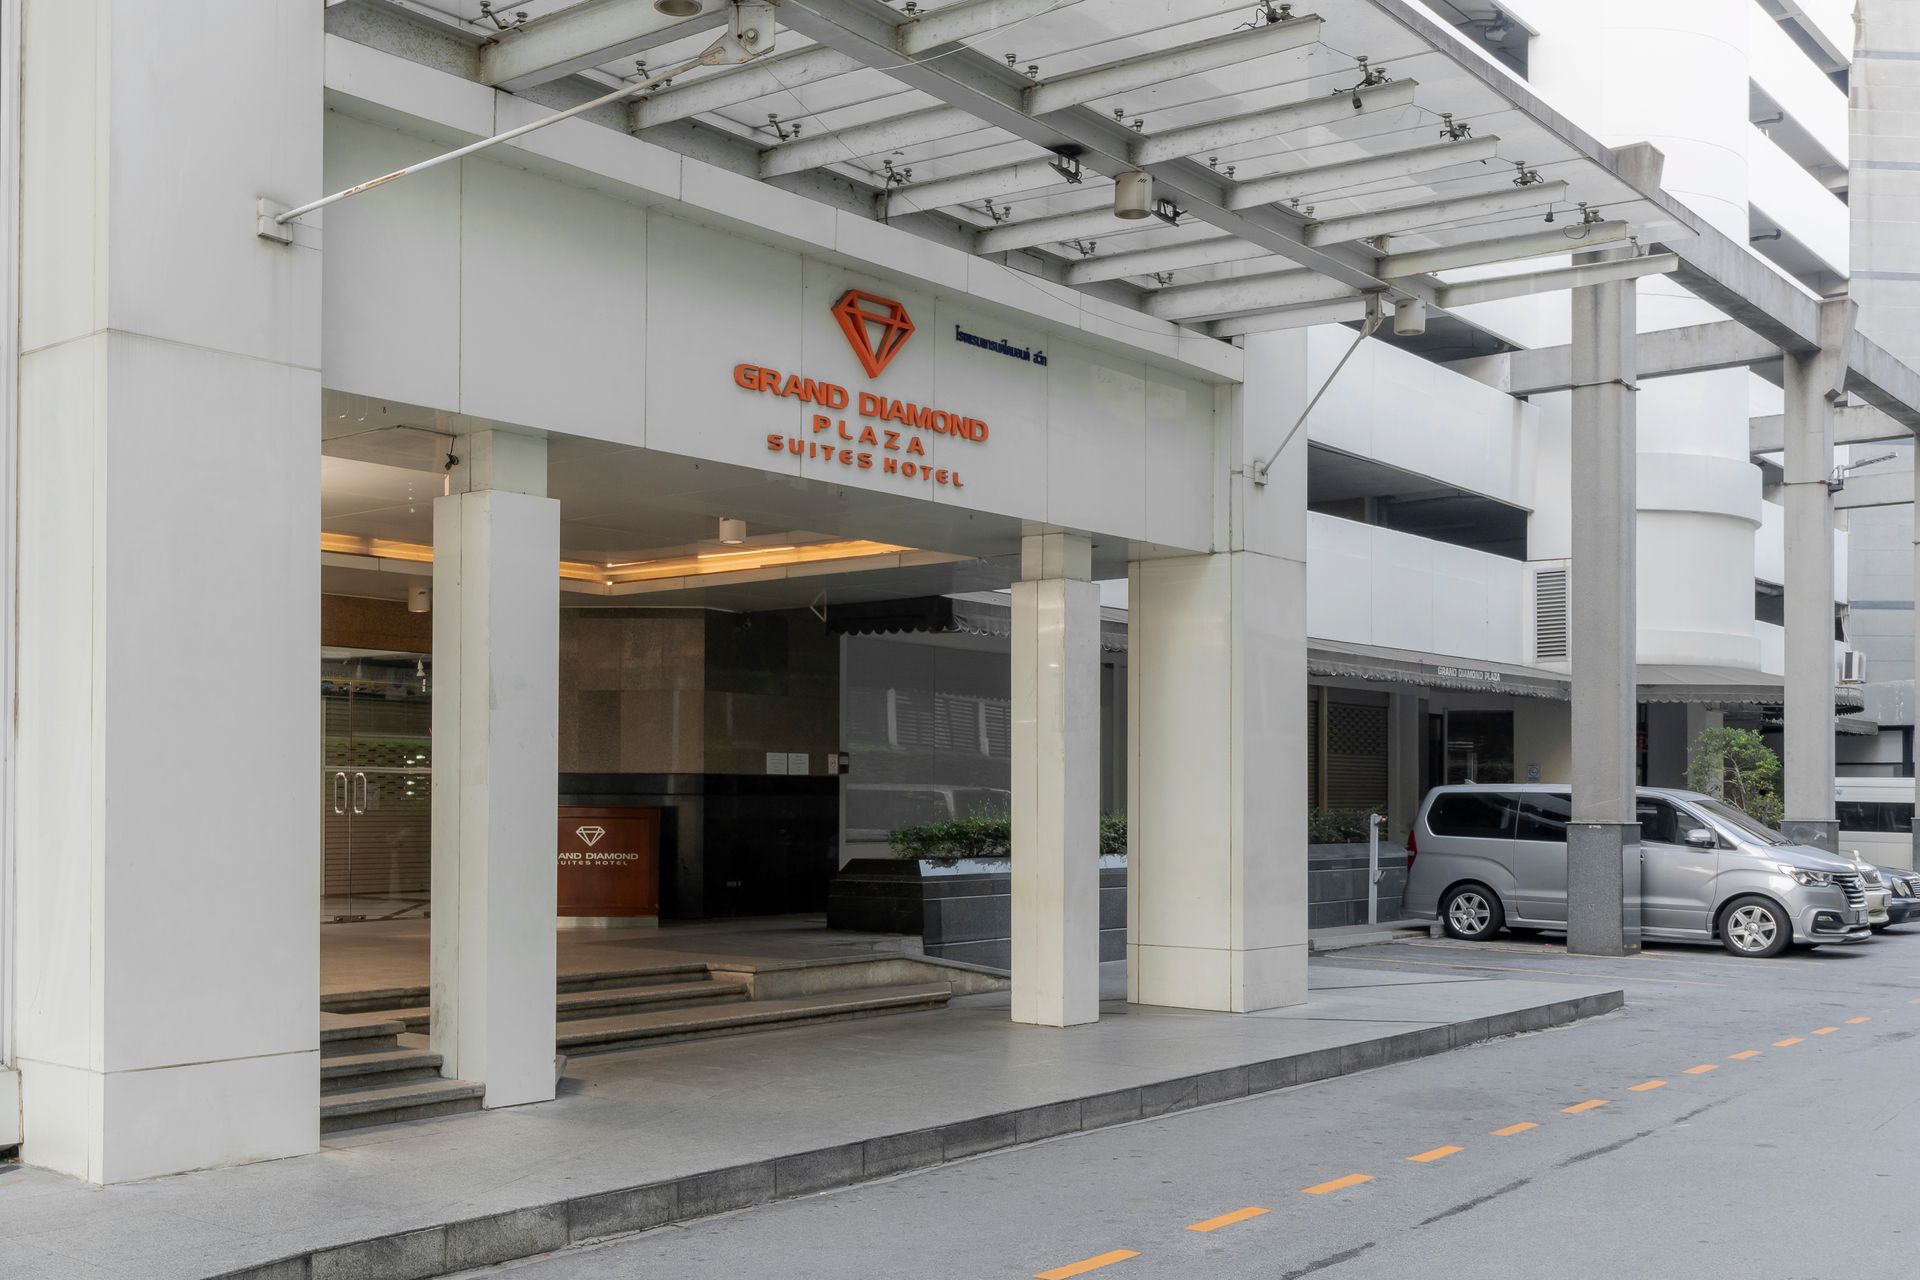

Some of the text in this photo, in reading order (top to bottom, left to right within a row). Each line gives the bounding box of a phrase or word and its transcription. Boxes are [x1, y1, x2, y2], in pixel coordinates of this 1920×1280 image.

[733, 363, 990, 442] GRAND DIAMOND
[812, 414, 926, 456] PLAZA
[767, 434, 964, 488] SUITES HOTEL
[1437, 666, 1501, 682] GRAND DIAMOND PLAZA
[558, 852, 639, 860] AND DIAMOND
